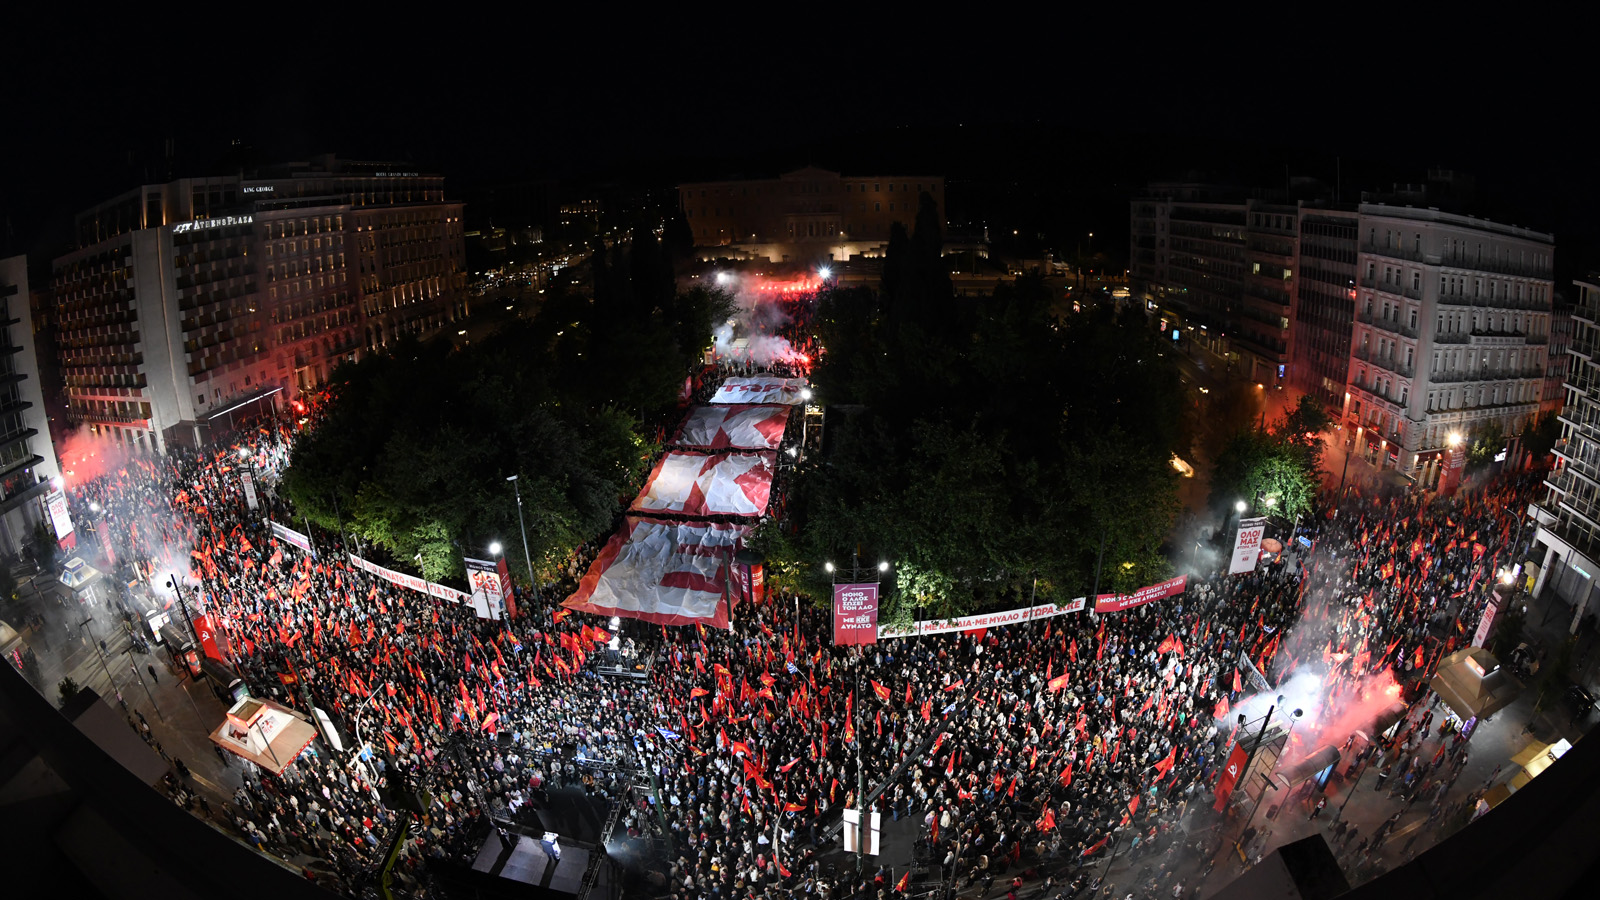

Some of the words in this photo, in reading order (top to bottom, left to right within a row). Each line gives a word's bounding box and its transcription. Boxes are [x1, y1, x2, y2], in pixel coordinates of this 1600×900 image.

[1240, 530, 1260, 538] ΟΛΟΙ
[1240, 537, 1258, 545] ΜΑΣ
[379, 568, 405, 583] ΔΥΝΑΤΟ
[443, 588, 454, 599] ΤΟ
[989, 613, 1019, 624] ΜΥΑΛΟ
